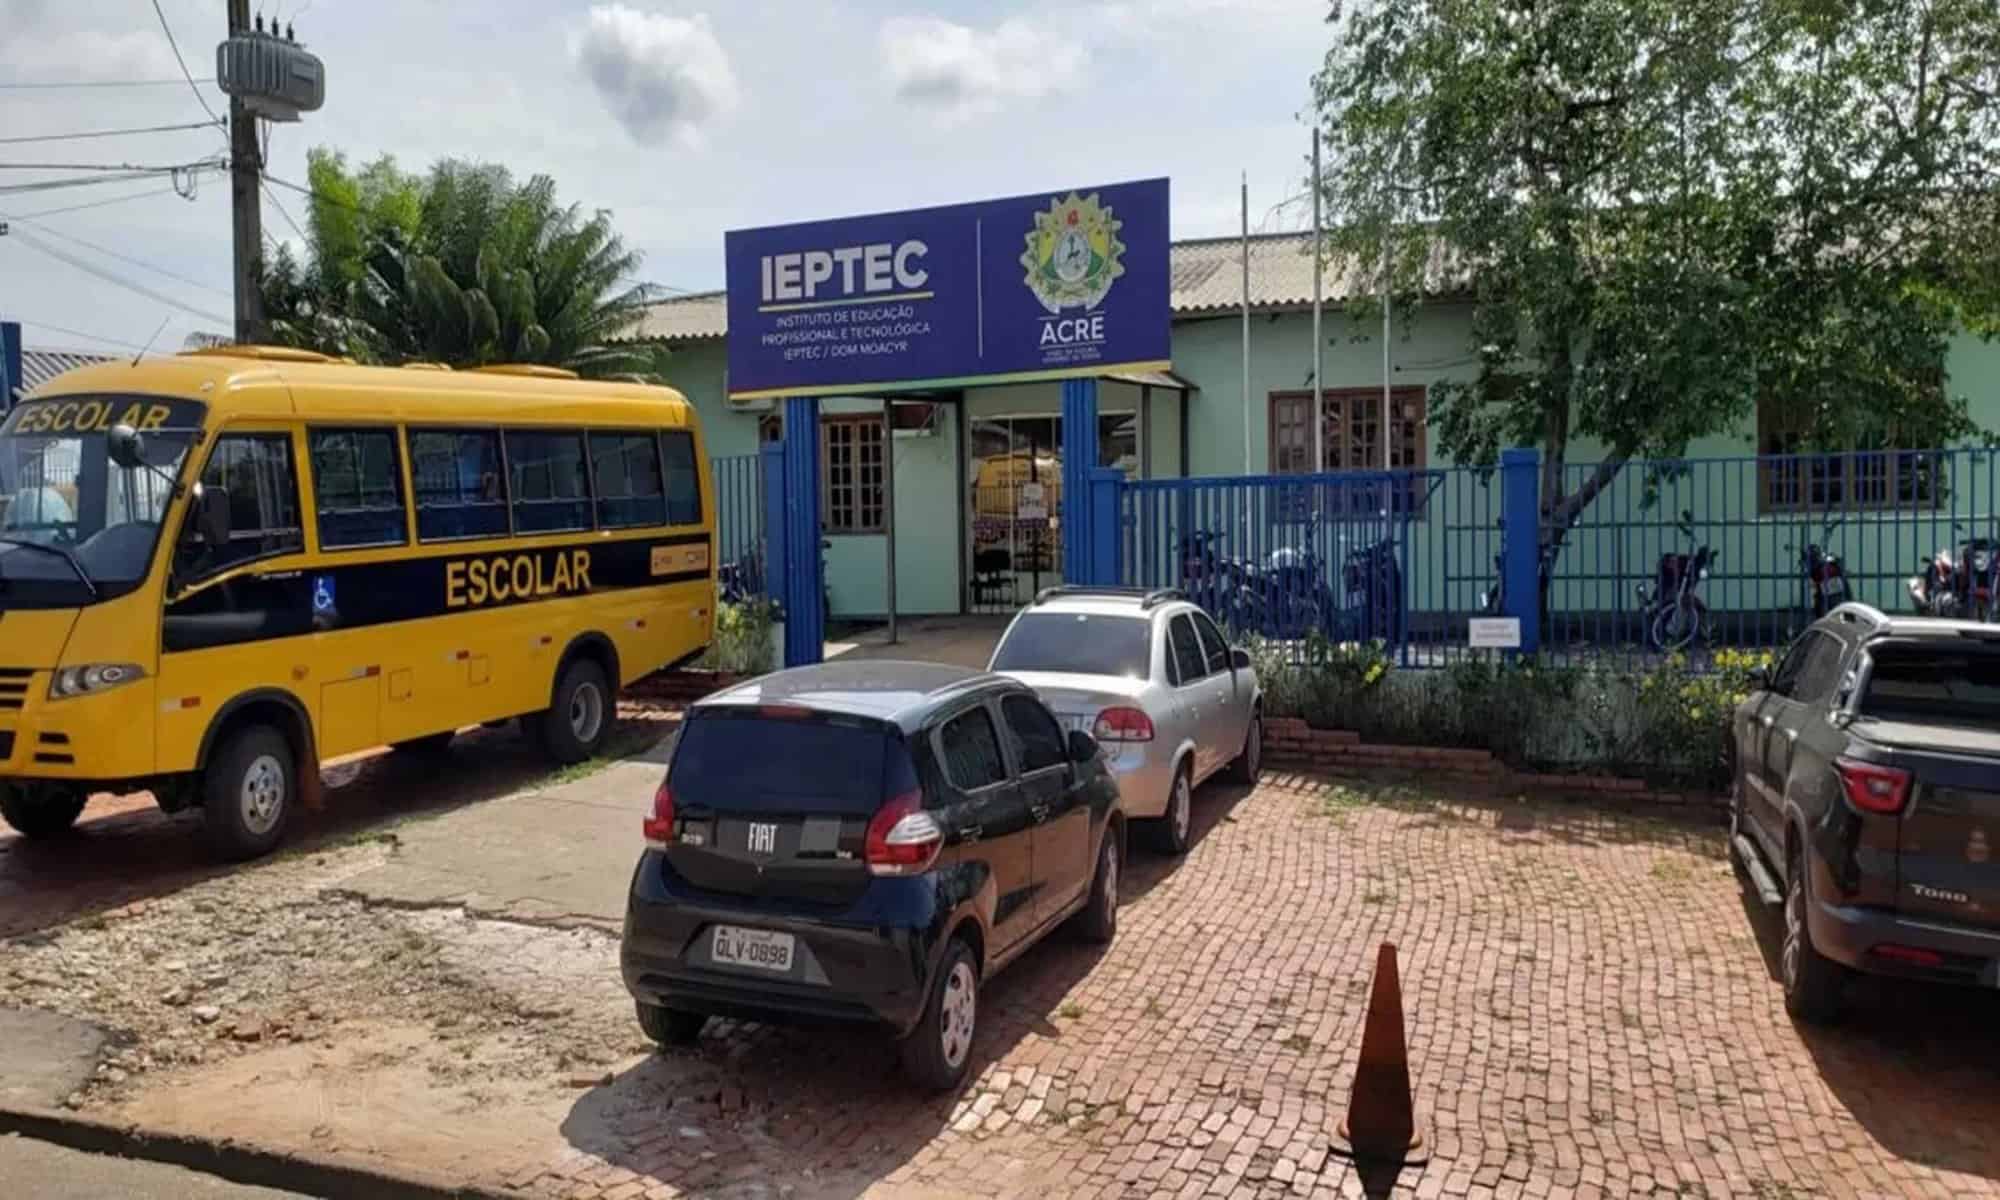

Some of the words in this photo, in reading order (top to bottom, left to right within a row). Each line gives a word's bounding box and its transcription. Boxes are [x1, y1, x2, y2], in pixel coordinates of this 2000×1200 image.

[761, 240, 928, 301] IEPTEC
[776, 312, 832, 328] INSTITUTO
[834, 310, 849, 323] DE
[852, 305, 914, 322] EDUCAÇÃO
[1040, 316, 1104, 344] ACRE
[762, 330, 839, 346] PROFISSIONAL
[841, 327, 848, 339] E
[851, 322, 931, 339] TECNOLÓGICA
[784, 346, 821, 361] IEPTEC
[831, 343, 858, 357] DOM
[860, 340, 909, 354] MOACYR
[14, 400, 171, 433] ESCOLAR
[446, 550, 592, 606] ESCOLAR
[748, 822, 778, 854] FIAT
